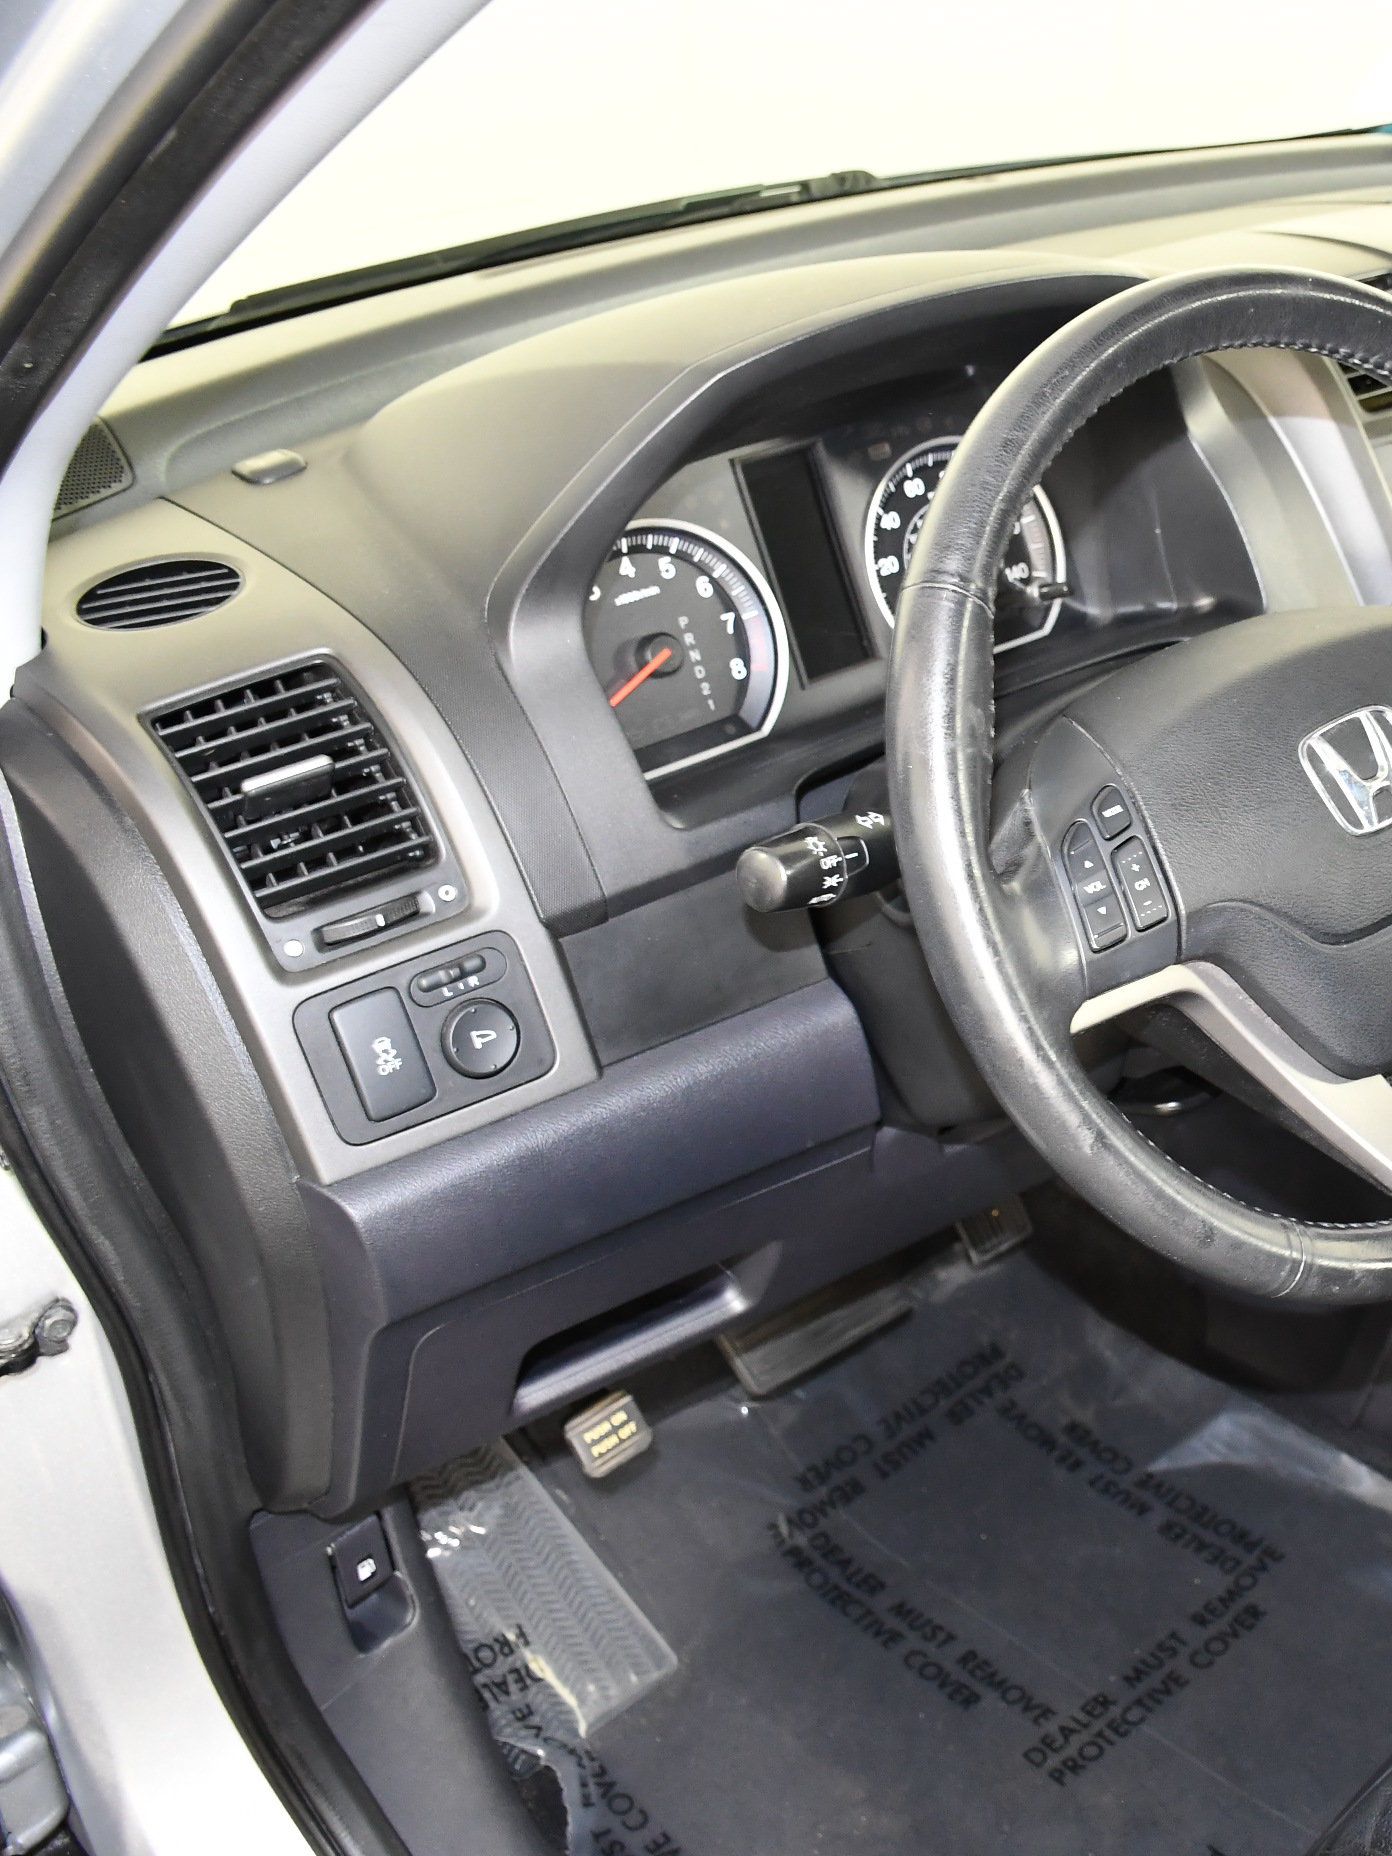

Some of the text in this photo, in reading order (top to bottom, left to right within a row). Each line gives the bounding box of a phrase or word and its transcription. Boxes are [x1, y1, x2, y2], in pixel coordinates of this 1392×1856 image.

[619, 556, 636, 578] 4
[658, 556, 676, 579] 5
[695, 575, 713, 598] 6
[720, 612, 735, 634] 7
[729, 658, 747, 680] 8
[794, 1434, 873, 1492] COVER
[874, 1427, 935, 1480] MUST
[998, 1400, 1244, 1577] DEALER MUST REMOVE
[1063, 1421, 1265, 1556] PROTECTIVE COVER
[781, 1544, 981, 1712] PROTECTIVE COVER
[808, 1530, 1057, 1727] DEALER MUST REMOVE
[1022, 1545, 1285, 1769] DEALER MUST REMOVE
[1047, 1604, 1267, 1788] PROTECTIVE COVER
